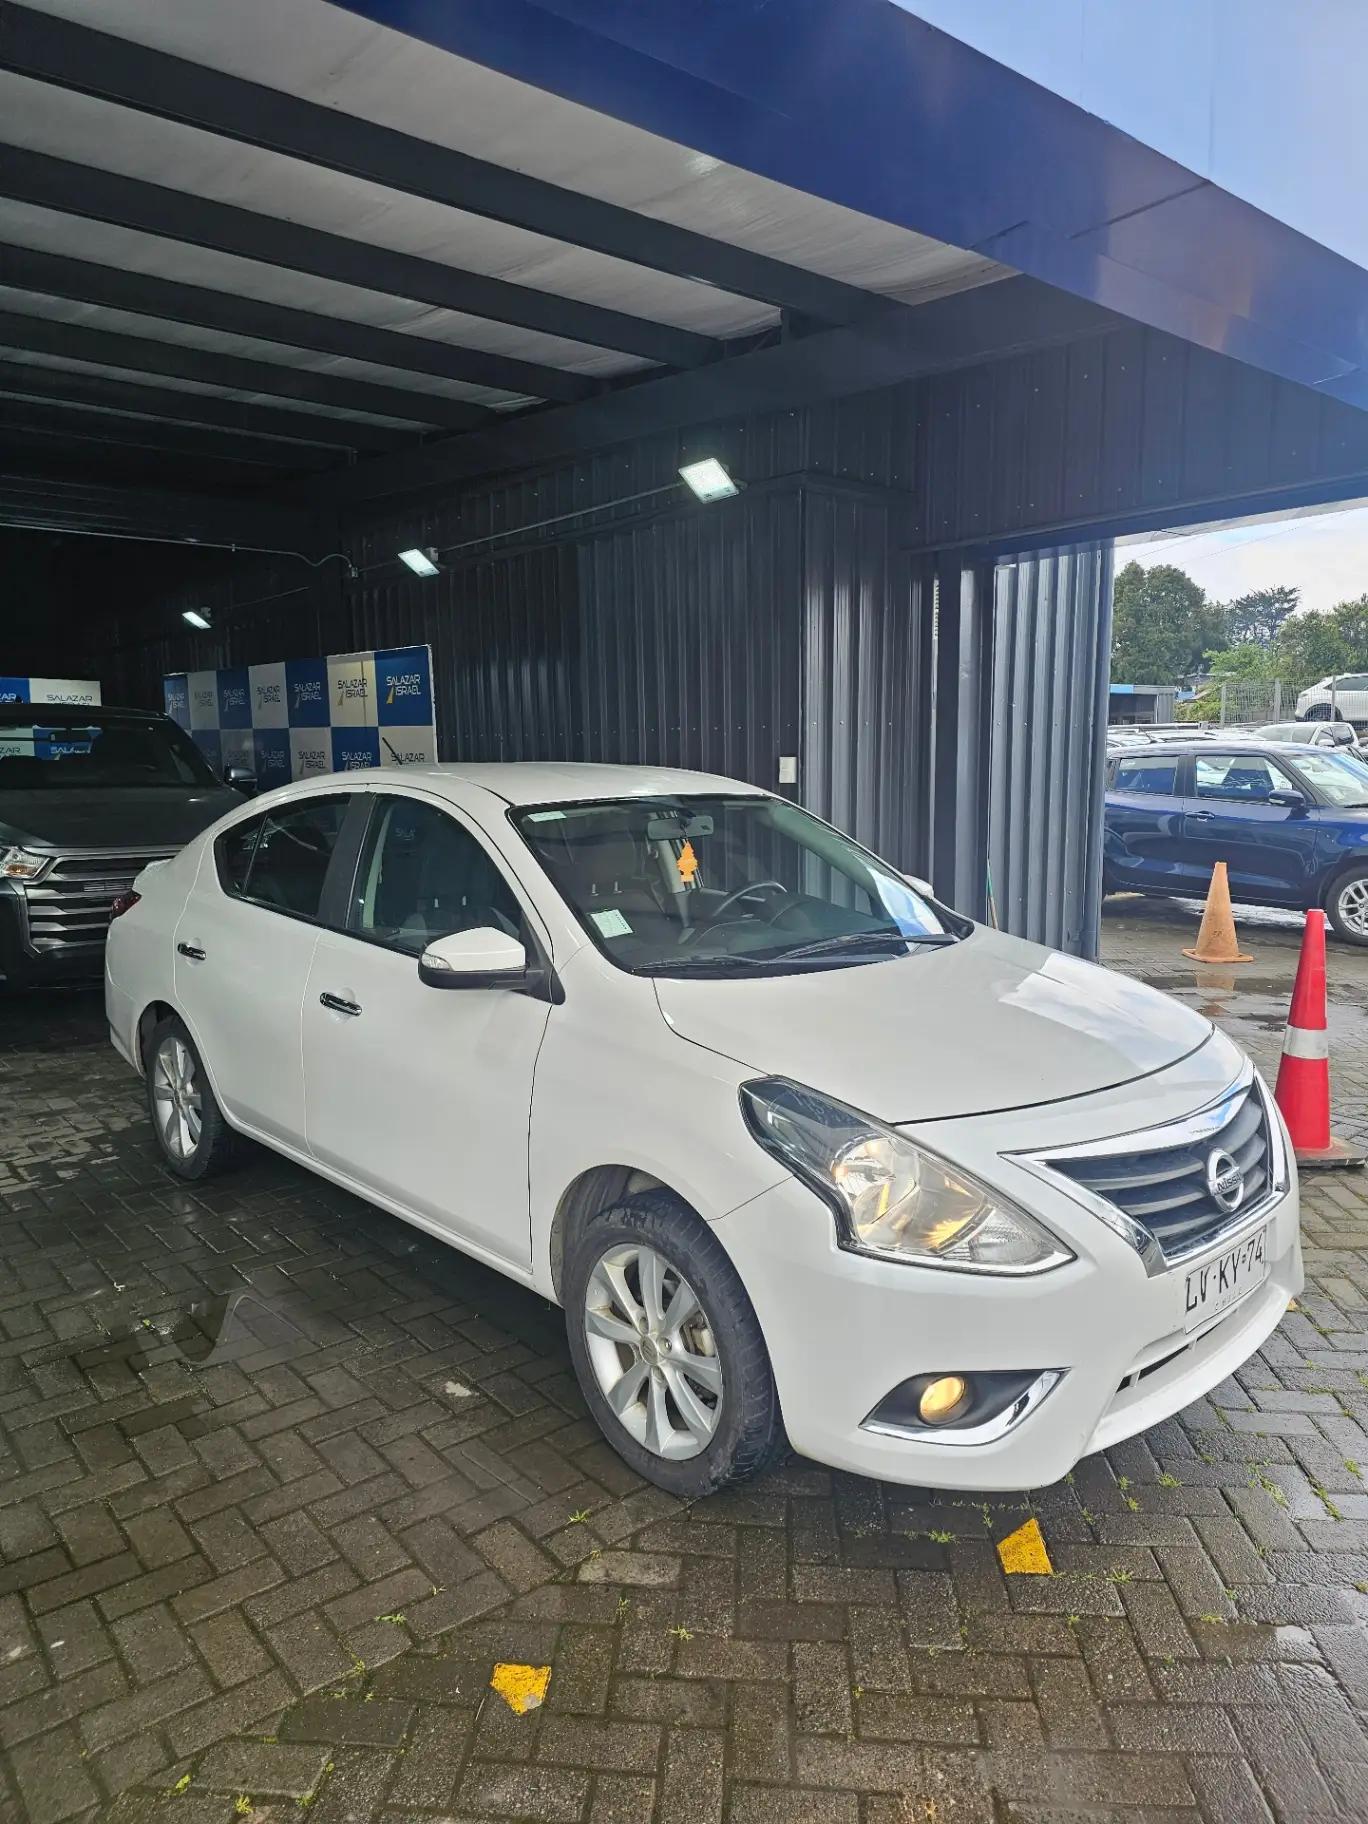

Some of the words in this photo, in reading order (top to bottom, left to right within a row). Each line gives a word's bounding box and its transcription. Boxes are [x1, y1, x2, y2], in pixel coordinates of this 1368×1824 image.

[337, 678, 368, 689] SALAZAR
[385, 673, 421, 686] SALAZAR
[346, 688, 368, 698] ISRAEL
[395, 685, 422, 696] ISRAEL
[46, 694, 93, 702] SALAZAR
[298, 751, 326, 761] SALAZAR
[341, 751, 372, 761] SALAZAR
